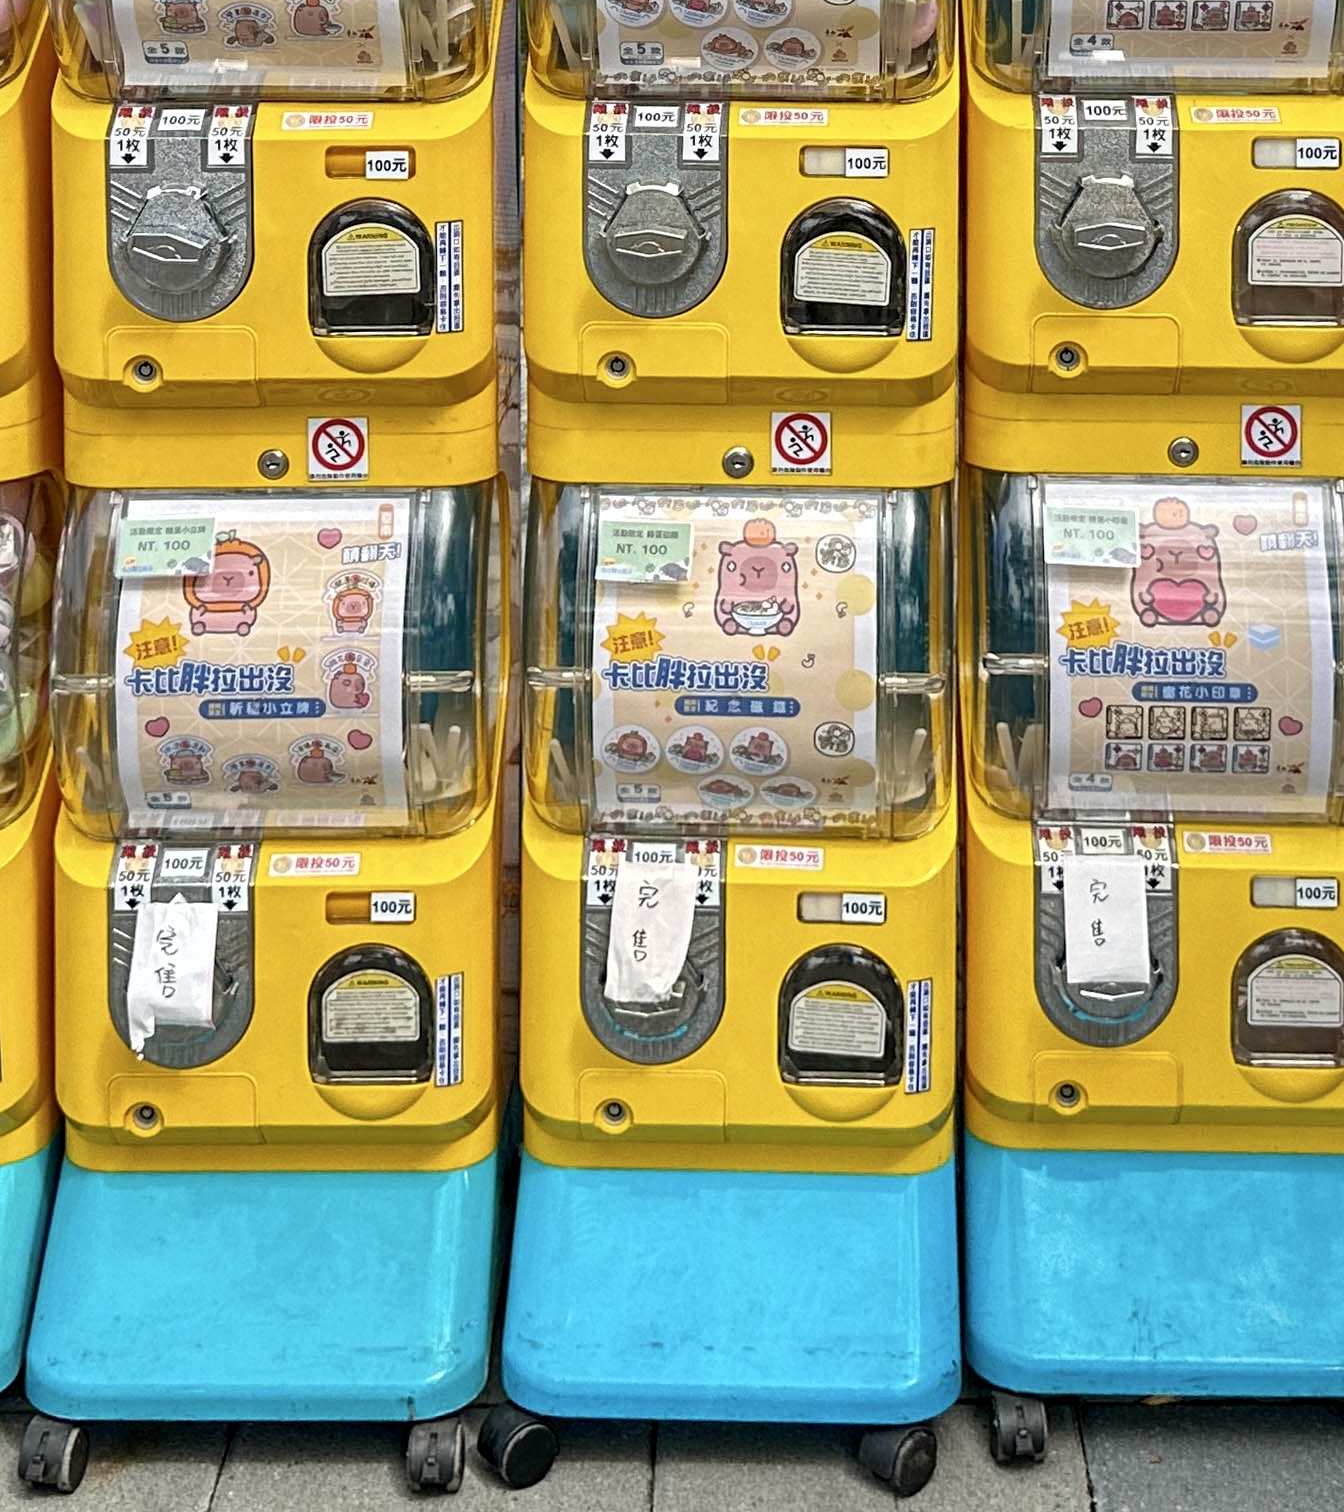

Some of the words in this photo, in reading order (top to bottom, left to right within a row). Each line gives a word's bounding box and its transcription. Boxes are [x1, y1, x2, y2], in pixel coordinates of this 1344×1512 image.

[637, 111, 676, 123] 100元
[1085, 105, 1125, 117] 100元
[1216, 108, 1276, 120] 限投50元
[161, 114, 200, 126] 100元
[308, 113, 369, 126] 限投50元
[1044, 116, 1075, 126] 50元
[1139, 116, 1170, 127] 50元
[114, 126, 146, 137] 50元
[211, 126, 243, 137] 50元
[592, 123, 624, 133] 50元
[687, 123, 718, 133] 50元
[1049, 128, 1072, 141] 1枚
[595, 135, 619, 148] 1枚
[690, 135, 713, 148] 1枚
[1143, 128, 1166, 142] 1枚
[116, 139, 140, 153] 1枚
[214, 139, 239, 153] 1枚
[1297, 146, 1338, 161] 100元
[367, 158, 407, 173] 100元
[847, 157, 887, 171] 100元
[1089, 529, 1114, 541] 100
[164, 539, 191, 551] 100
[642, 544, 667, 556] 100
[1068, 616, 1109, 640] 注意!
[135, 635, 177, 660] 注意!
[612, 631, 654, 655] 注意!
[1058, 642, 1227, 677] 卡比胖拉出沒
[124, 662, 295, 697] 卡比胖拉出沒
[602, 657, 768, 691] 卡比胖拉出沒
[1083, 835, 1123, 848] 100元
[1209, 835, 1268, 849] 限投50元
[634, 851, 673, 863] 100元
[760, 849, 819, 863] 限投50元
[164, 856, 204, 870] 100元
[295, 856, 356, 870] 限投50元
[119, 871, 150, 882] 50元
[216, 871, 246, 882] 50元
[121, 884, 145, 898] 1枚
[218, 885, 242, 899] 1枚
[1296, 886, 1336, 900] 100元
[372, 899, 413, 915] 100元
[843, 901, 882, 916] 100元
